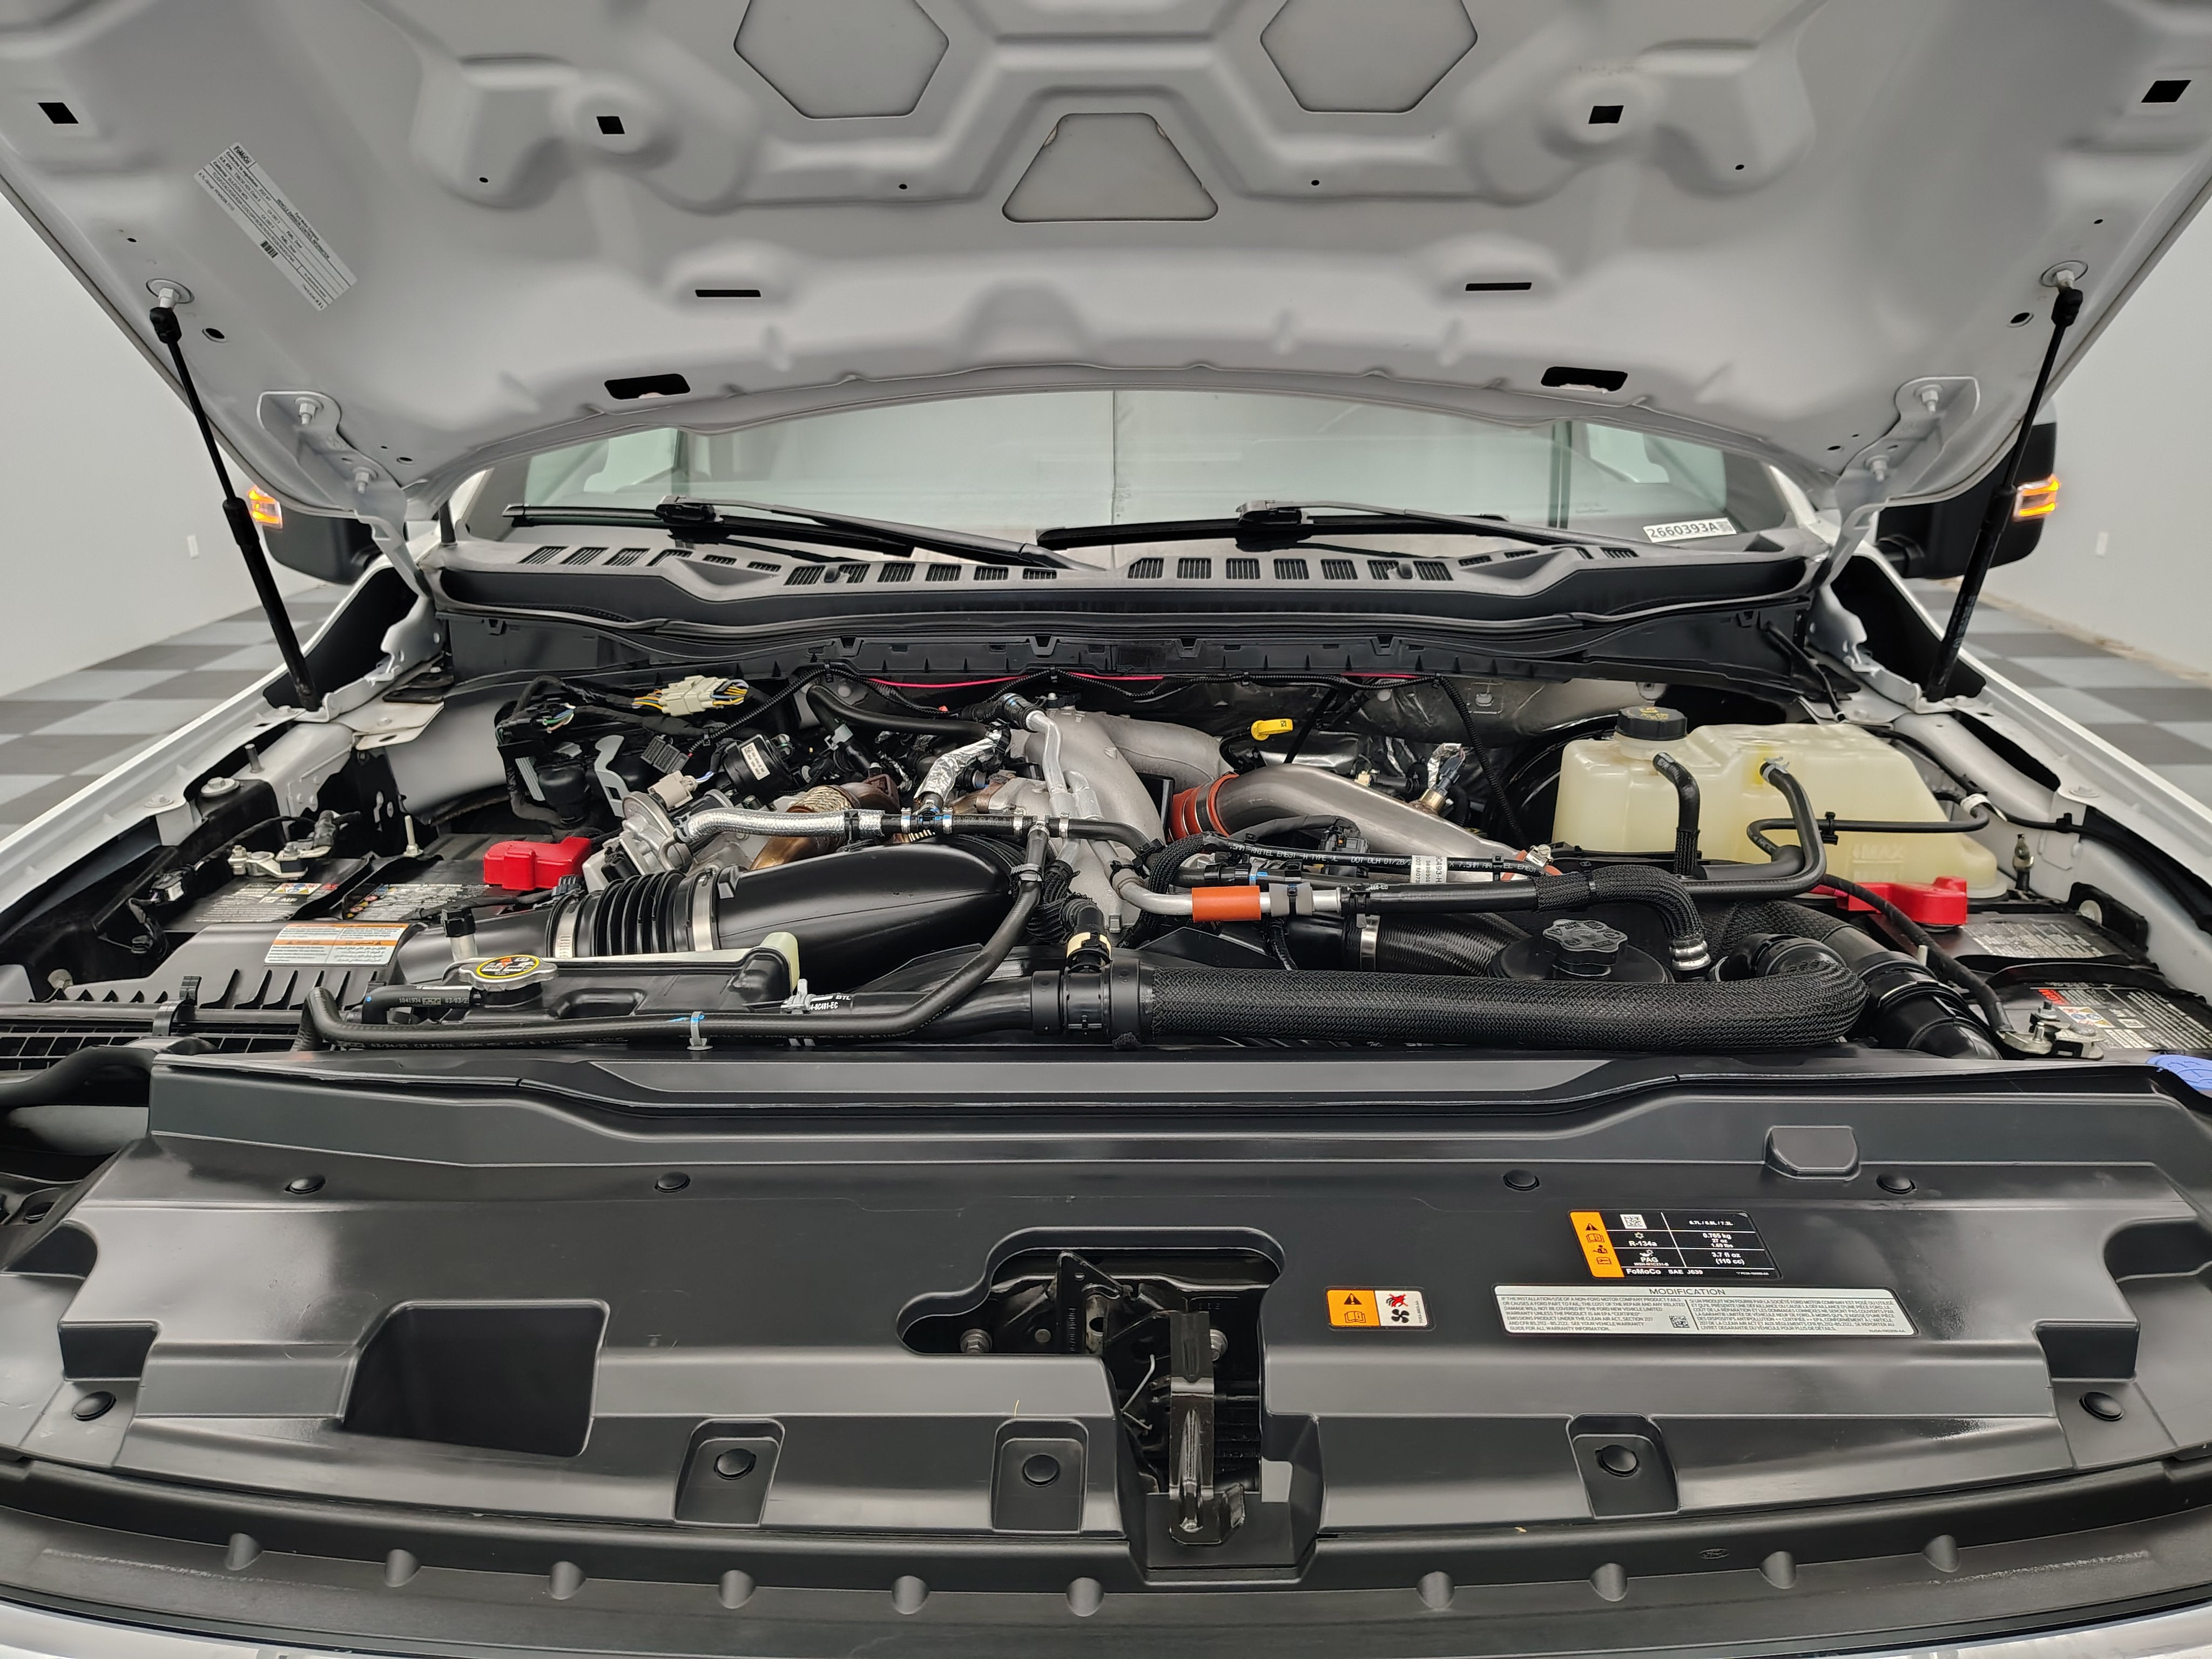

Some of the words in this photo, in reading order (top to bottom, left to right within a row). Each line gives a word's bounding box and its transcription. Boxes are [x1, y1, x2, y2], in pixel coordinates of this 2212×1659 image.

[233, 145, 251, 164] FoMoCo
[1647, 522, 1719, 538] 2660393A
[1251, 847, 1274, 857] RNITEL
[1517, 864, 1537, 873] EM631
